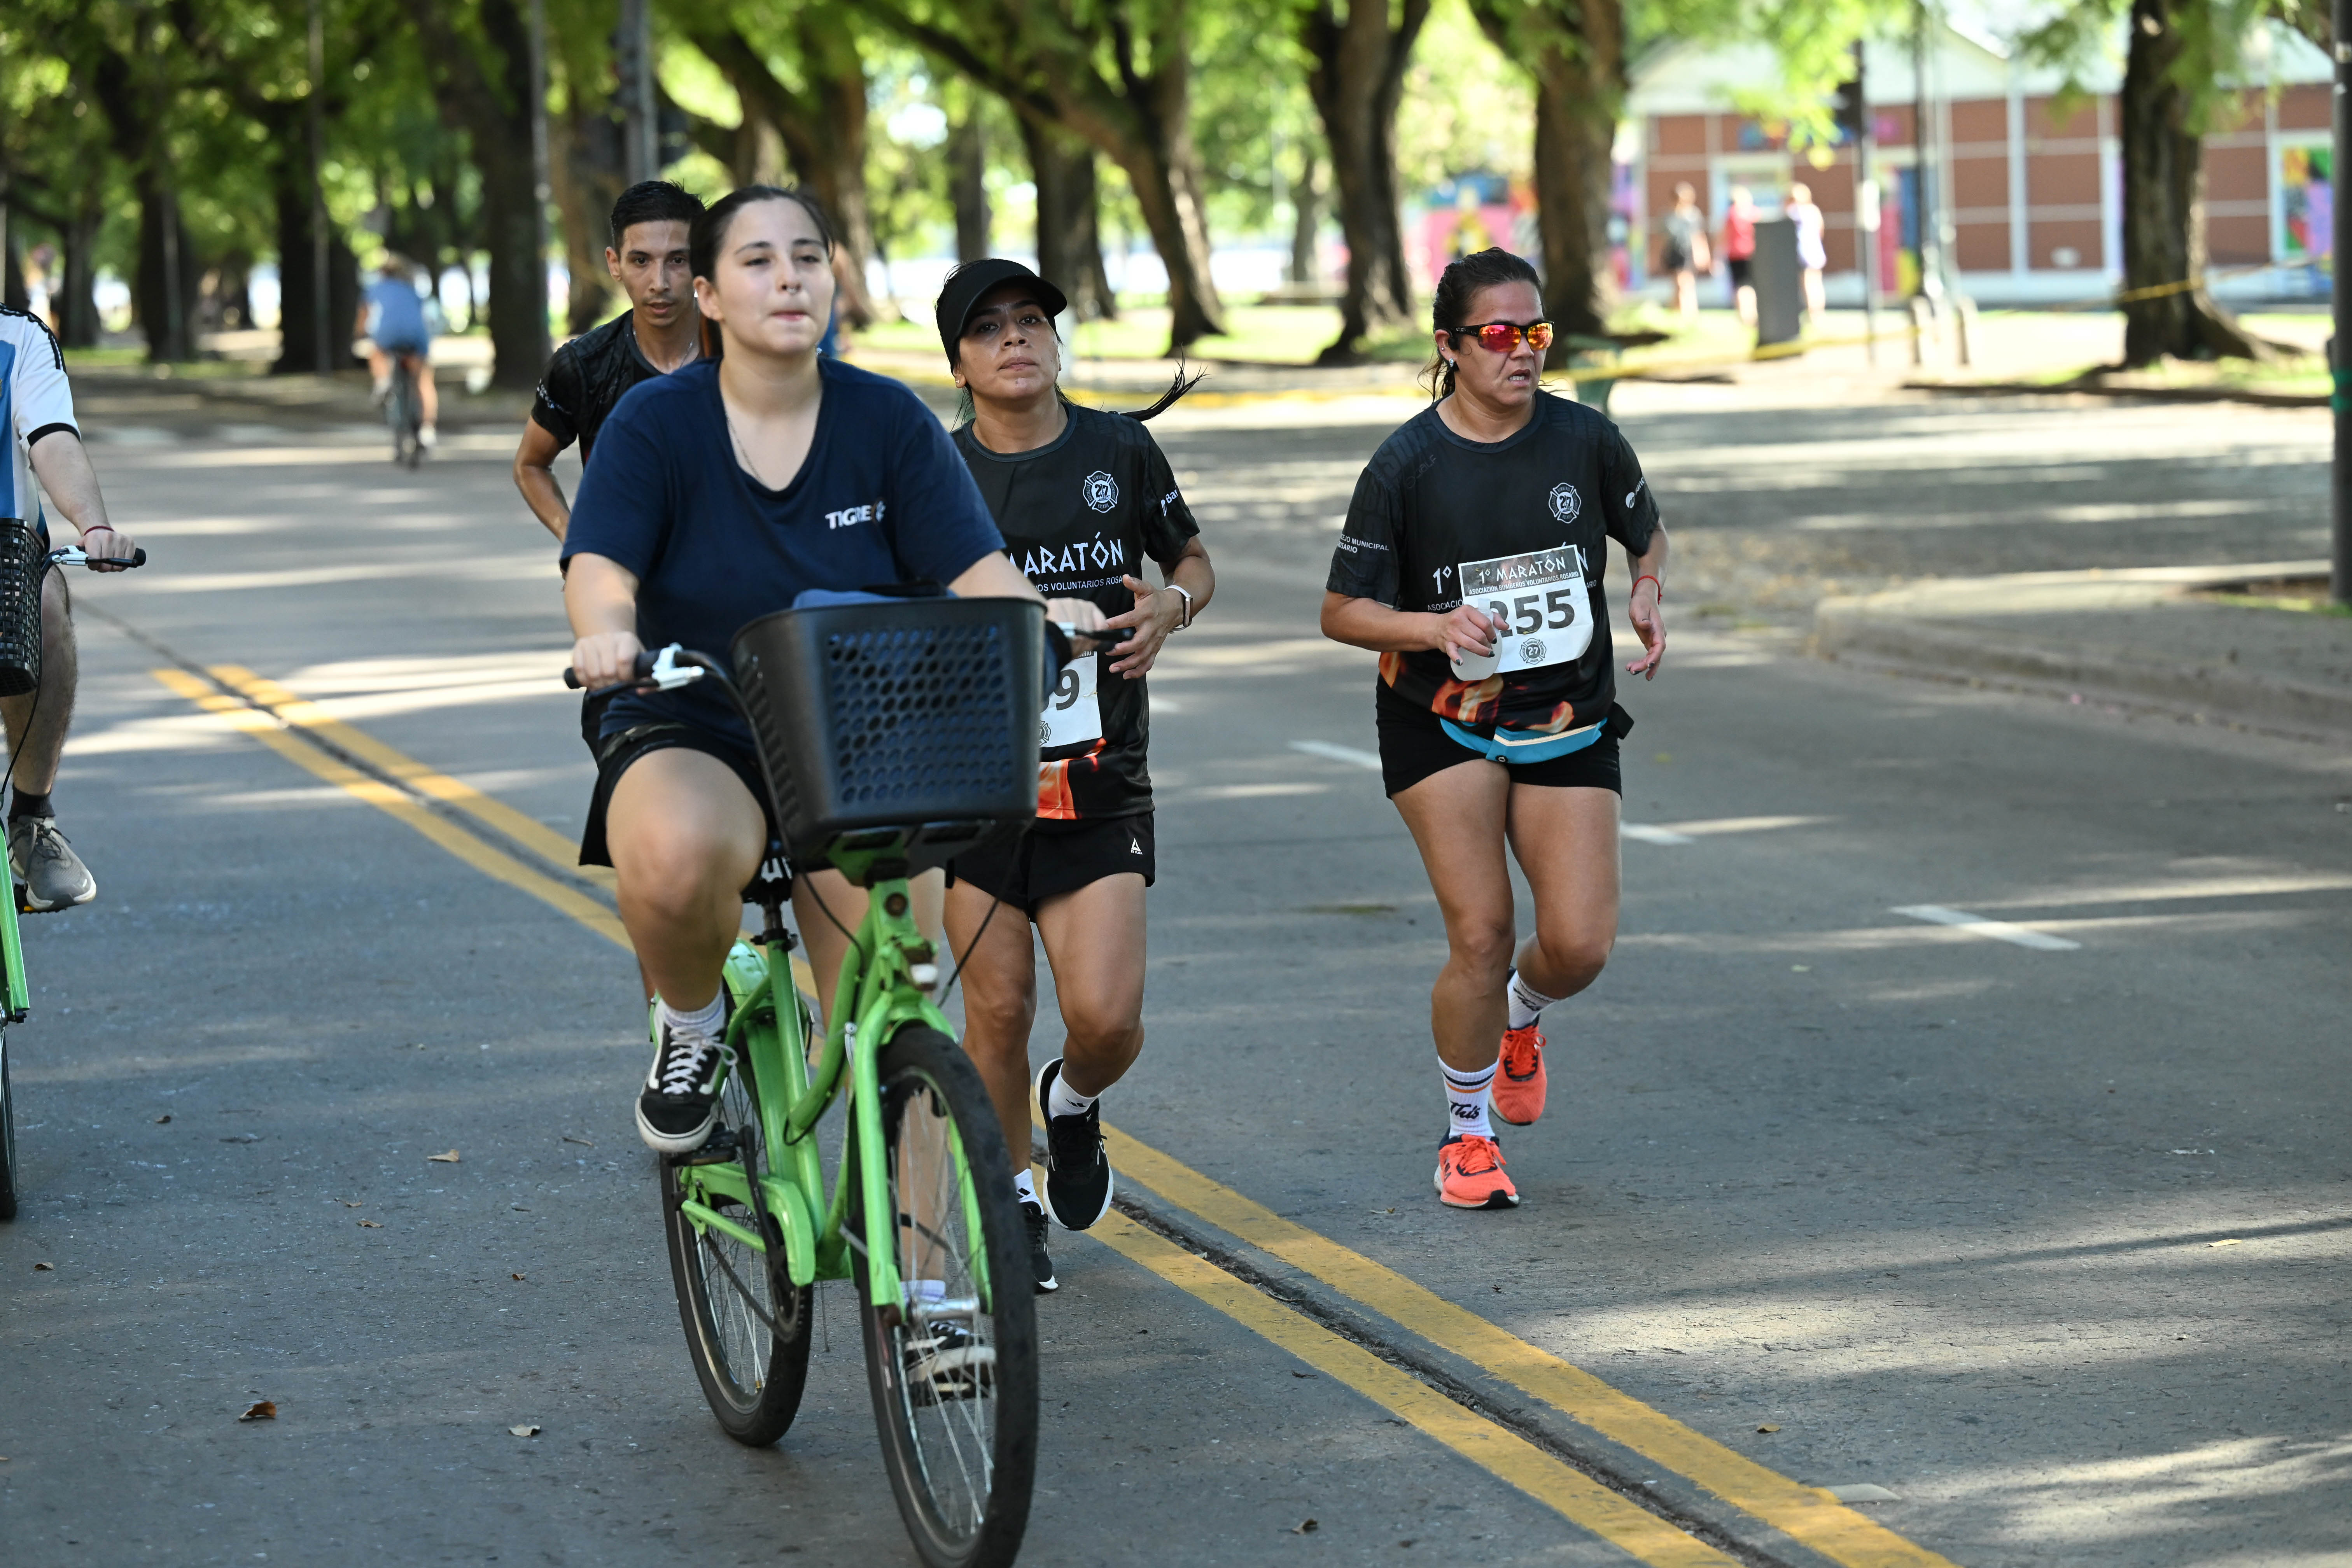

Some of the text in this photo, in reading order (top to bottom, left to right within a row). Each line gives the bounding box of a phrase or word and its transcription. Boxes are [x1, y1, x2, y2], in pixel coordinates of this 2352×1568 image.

[1094, 484, 1108, 498] 27
[1559, 495, 1572, 509] 27
[1351, 538, 1389, 551] MUNICIPAL
[1010, 531, 1124, 578] ARATÓN
[1496, 555, 1566, 581] MARATÓN
[1050, 579, 1104, 591] VOLUNTARIOS
[1106, 576, 1123, 586] ROSA
[1469, 571, 1579, 595] ASOCIACIÓN BOMBEROS VOLUNTARIOS ROSARIO
[1587, 579, 1597, 588] ARIO
[1428, 597, 1463, 611] ASOCIACIÓ
[1528, 646, 1538, 656] 27
[1041, 669, 1080, 713] 9
